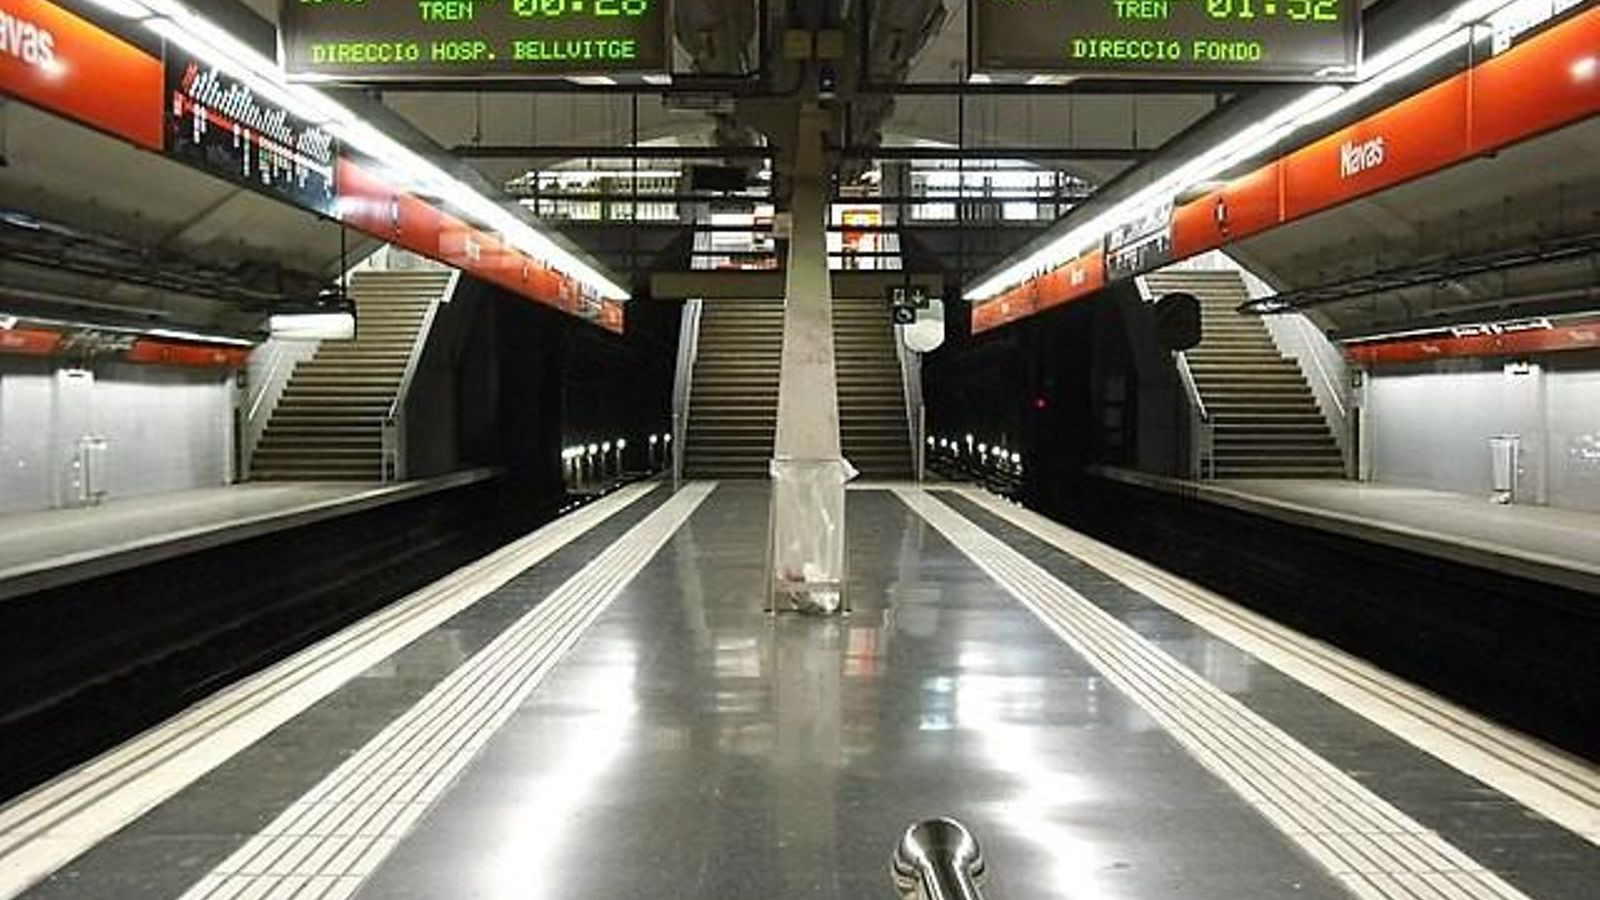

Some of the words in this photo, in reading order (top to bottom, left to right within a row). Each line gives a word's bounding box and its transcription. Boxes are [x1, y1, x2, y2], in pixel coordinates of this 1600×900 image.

[418, 1, 473, 20] TREN
[1113, 0, 1168, 18] TREN
[432, 40, 496, 61] HOSP.
[513, 40, 636, 60] BELLVITGE
[1193, 41, 1262, 61] FONDO
[1341, 136, 1383, 179] Navas
